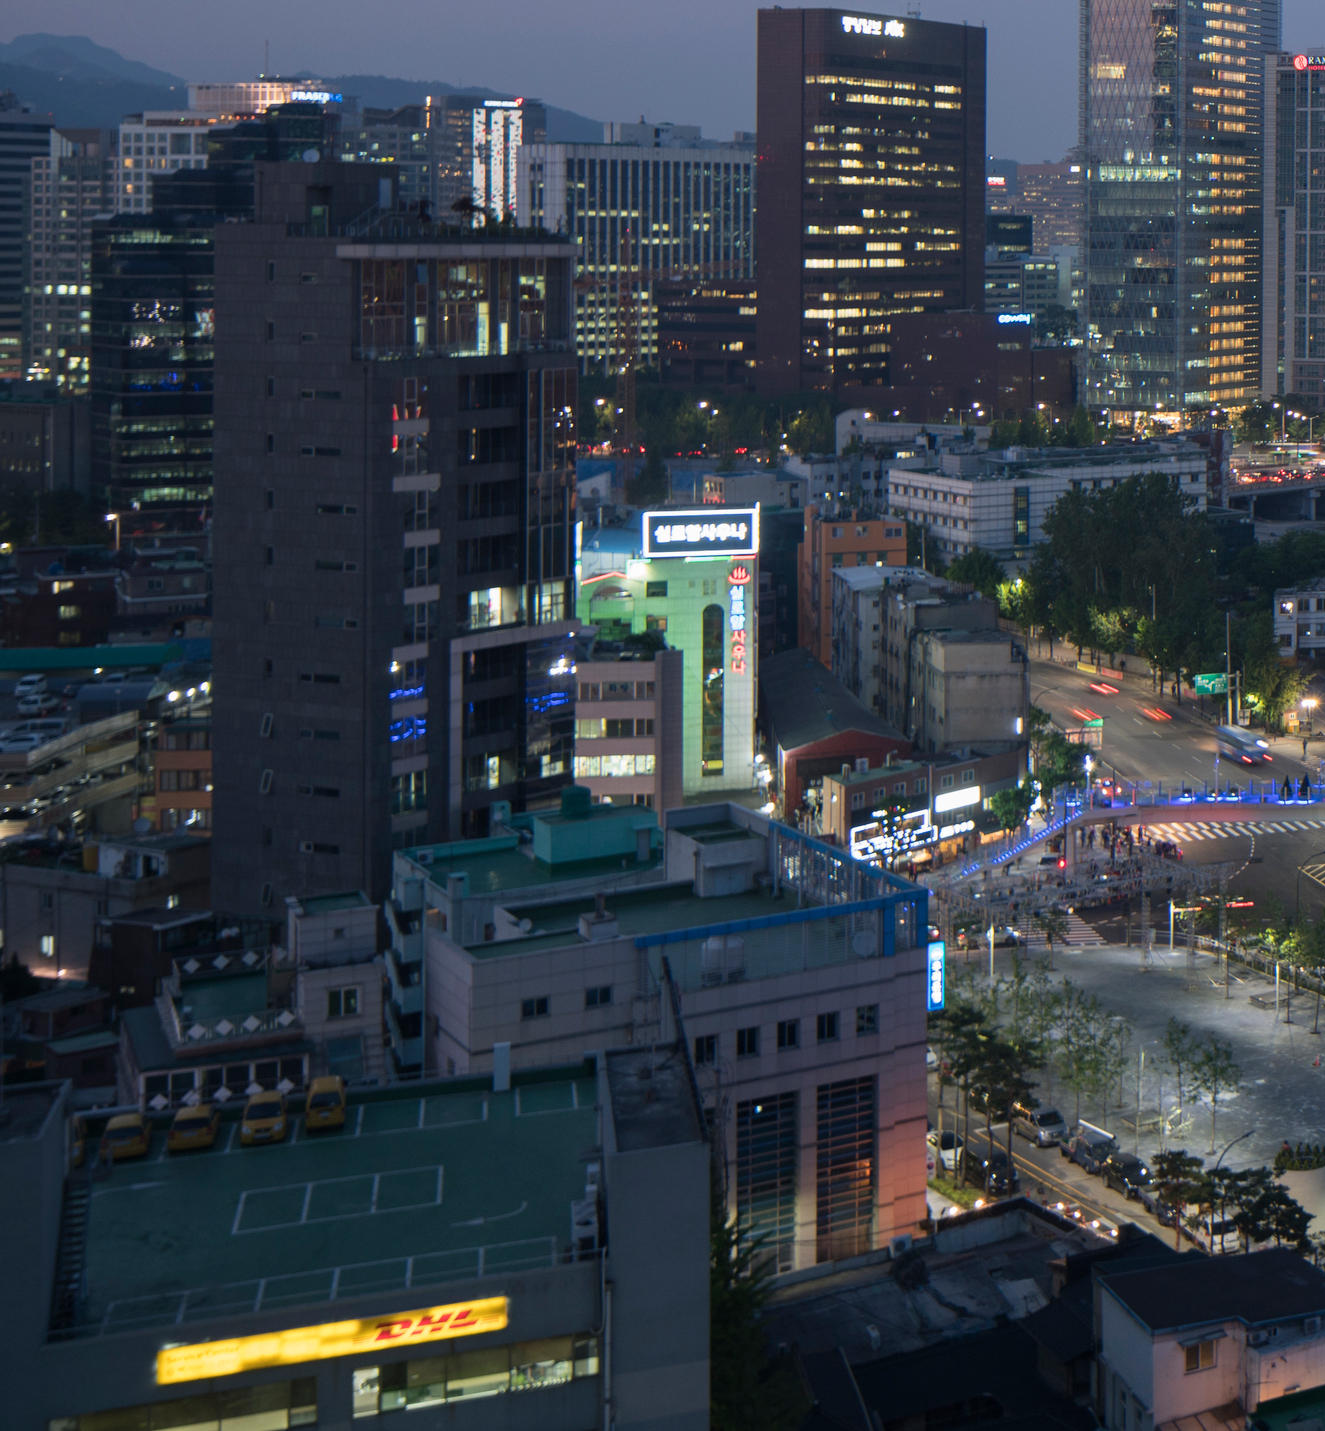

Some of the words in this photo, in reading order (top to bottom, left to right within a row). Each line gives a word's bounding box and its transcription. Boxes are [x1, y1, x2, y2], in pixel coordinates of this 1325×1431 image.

[655, 522, 748, 543] 실로암사우나
[730, 585, 746, 675] 실로암사우나
[376, 1309, 481, 1342] DHL
